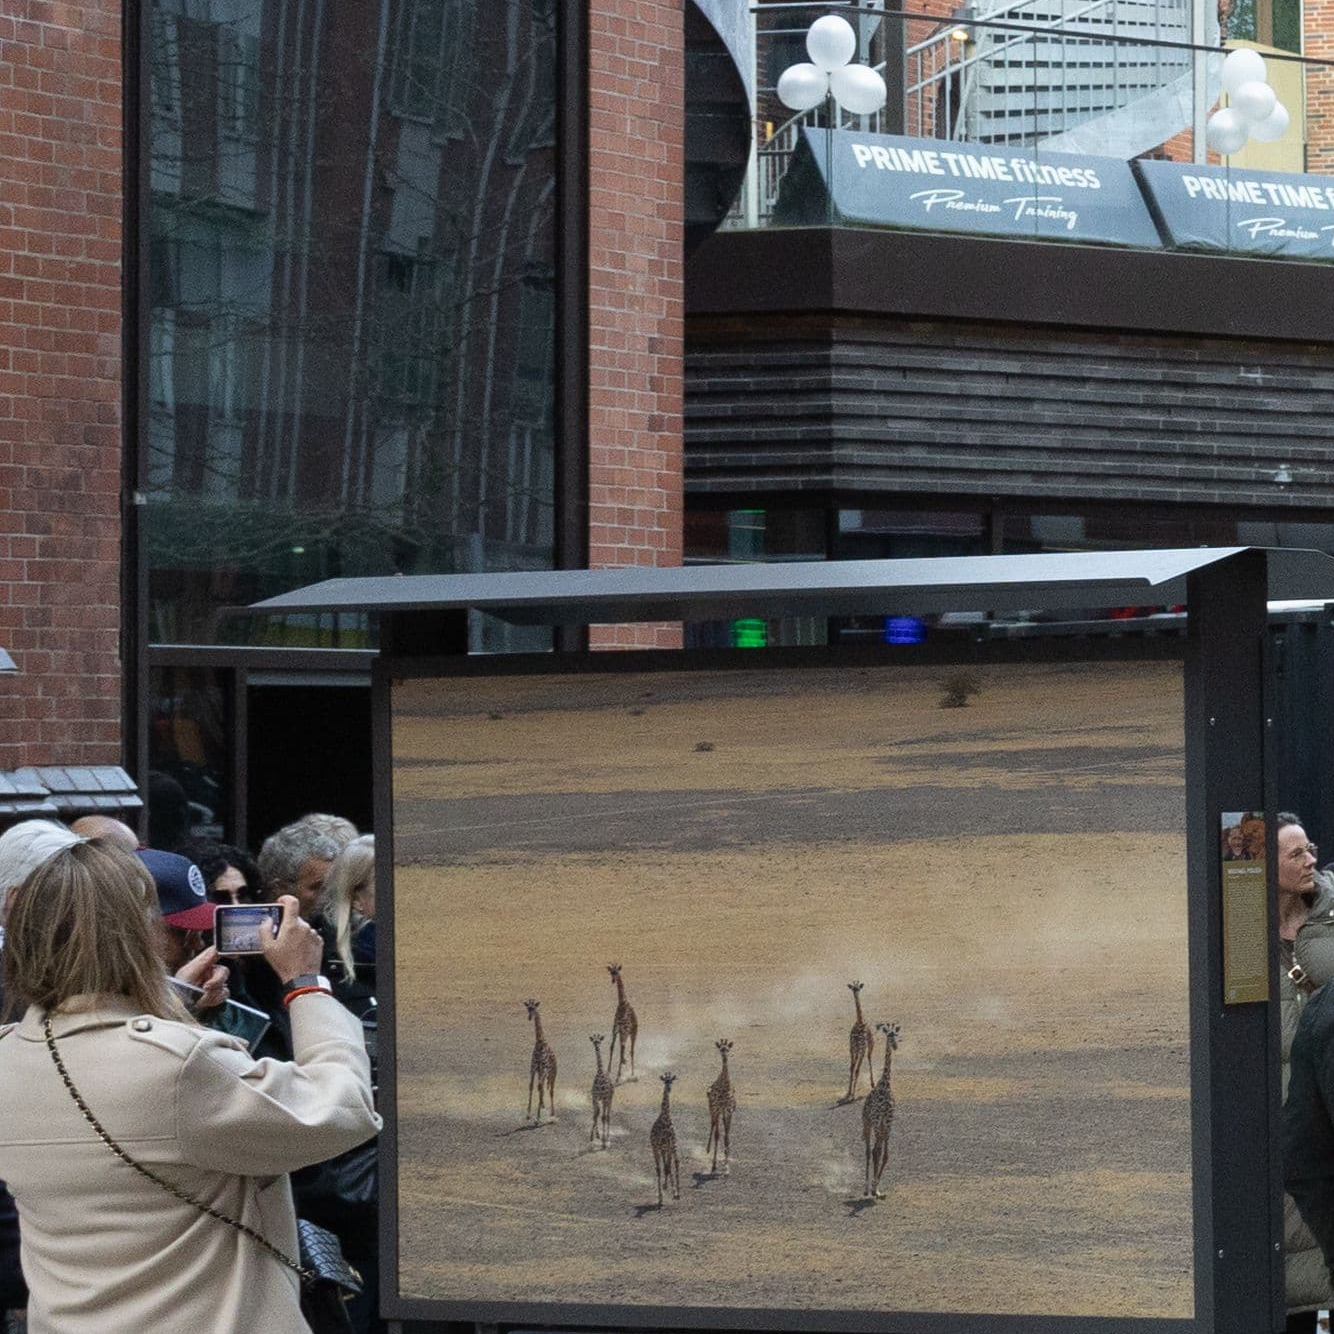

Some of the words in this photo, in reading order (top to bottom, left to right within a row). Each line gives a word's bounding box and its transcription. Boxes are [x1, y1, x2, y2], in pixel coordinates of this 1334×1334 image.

[851, 144, 945, 175] PRIME
[942, 152, 1013, 182] TIME
[1009, 157, 1101, 189] fitness
[909, 189, 1001, 212] Premium
[1003, 196, 1078, 230] Training
[1182, 175, 1267, 205] PRIME
[1264, 182, 1330, 211] TIME
[1237, 218, 1319, 240] Premium
